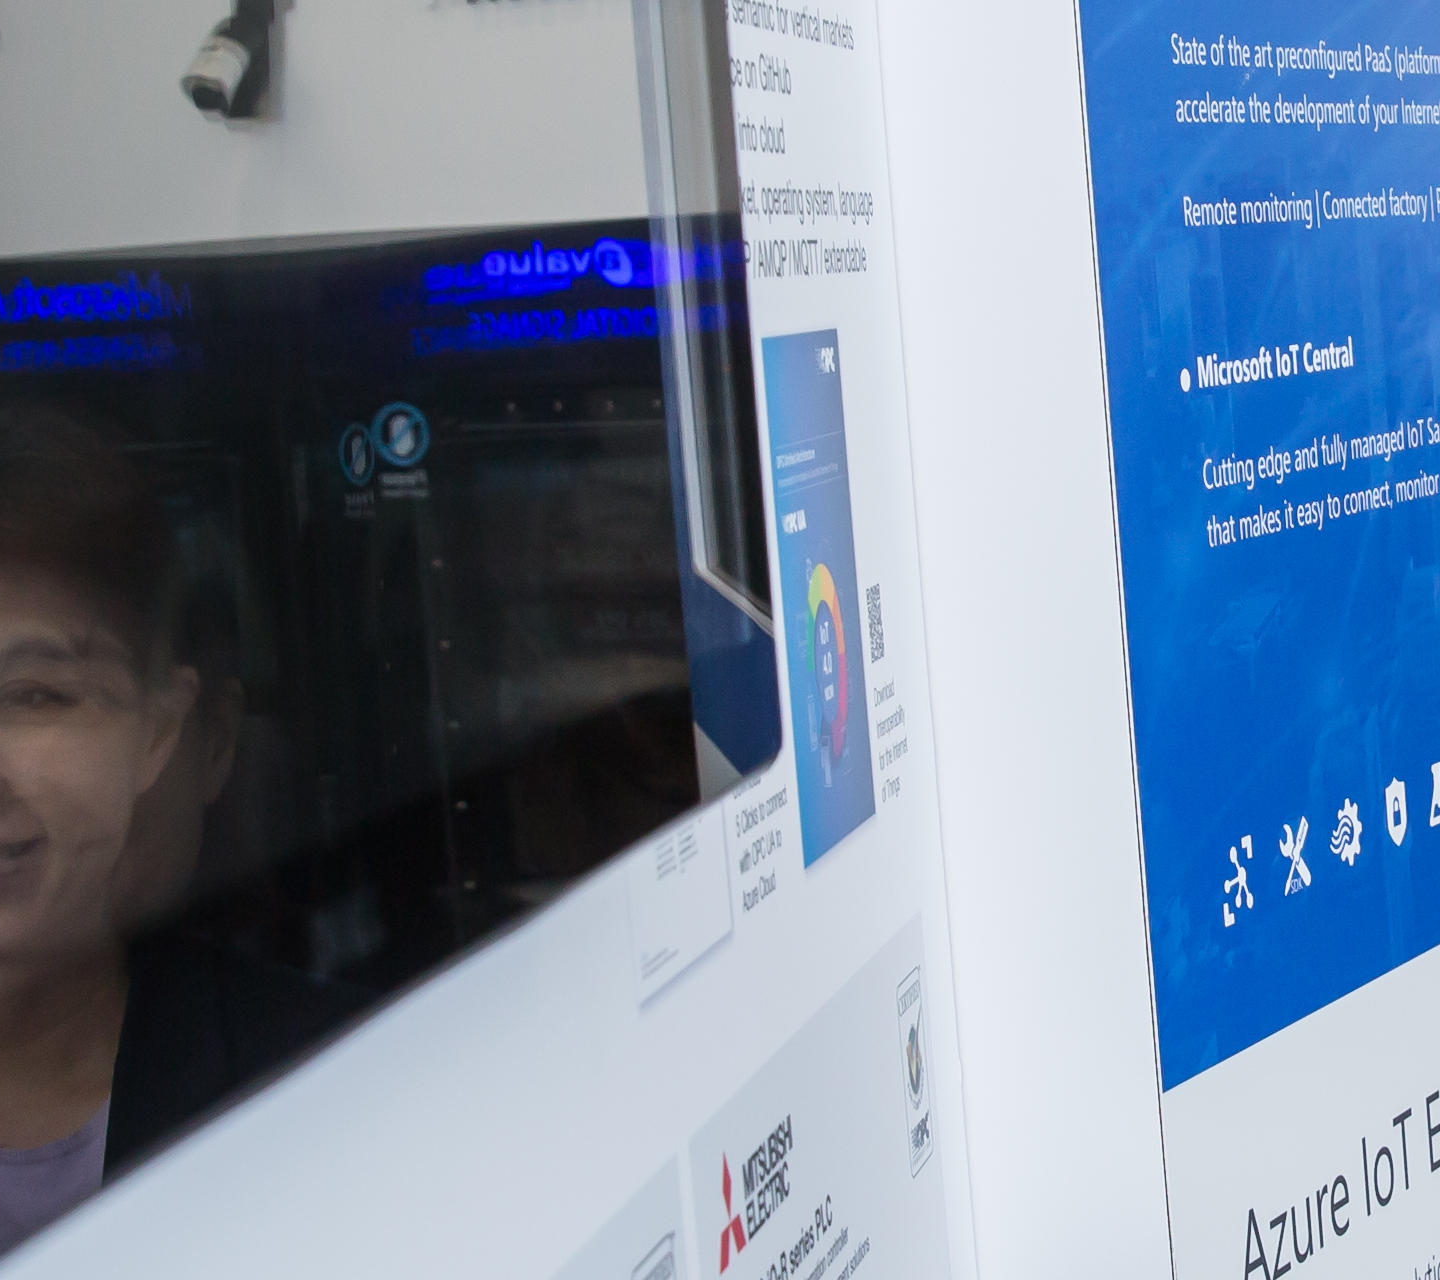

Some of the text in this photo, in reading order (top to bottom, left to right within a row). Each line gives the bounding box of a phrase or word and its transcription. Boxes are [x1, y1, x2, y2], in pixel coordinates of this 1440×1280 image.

[790, 3, 822, 44] vertical
[822, 15, 854, 51] markets
[745, 52, 792, 95] on GitHub
[1171, 33, 1207, 66] State
[1210, 34, 1224, 66] of
[1227, 35, 1251, 67] the
[1254, 41, 1273, 68] art
[1276, 40, 1362, 79] preconfigured
[1365, 44, 1392, 73] PaaS
[738, 112, 786, 155] into cloud
[1176, 91, 1245, 123] accelerate
[1248, 92, 1270, 123] the
[1274, 93, 1356, 131] development
[1358, 95, 1370, 124] of
[1373, 103, 1398, 133] your
[761, 180, 873, 226] operating system, language
[1183, 196, 1236, 227] Remote
[1241, 192, 1313, 229] monitoring
[1323, 188, 1387, 220] Connected
[1389, 187, 1427, 223] factory
[758, 239, 867, 280] AMQP MQTT extendable
[1197, 335, 1354, 389] Microsoft IoT Central
[1203, 453, 1255, 490] Cutting
[1258, 446, 1291, 485] edge
[1295, 438, 1318, 471] and
[1321, 434, 1348, 471] fully
[1350, 421, 1405, 461] managed
[1407, 419, 1424, 448] IoT
[1207, 515, 1237, 547] that
[1239, 504, 1281, 540] makes
[1284, 500, 1295, 530] it
[1297, 499, 1324, 530] easy
[1328, 494, 1340, 519] to
[1344, 480, 1393, 516] connect,
[1396, 470, 1439, 503] monitor
[874, 678, 894, 706] Download
[742, 1113, 793, 1199] MITSUBISHI
[1362, 1107, 1412, 1217] IoT
[746, 1162, 790, 1242] ELECTRIC
[789, 1226, 815, 1274] series
[815, 1194, 833, 1242] PLC
